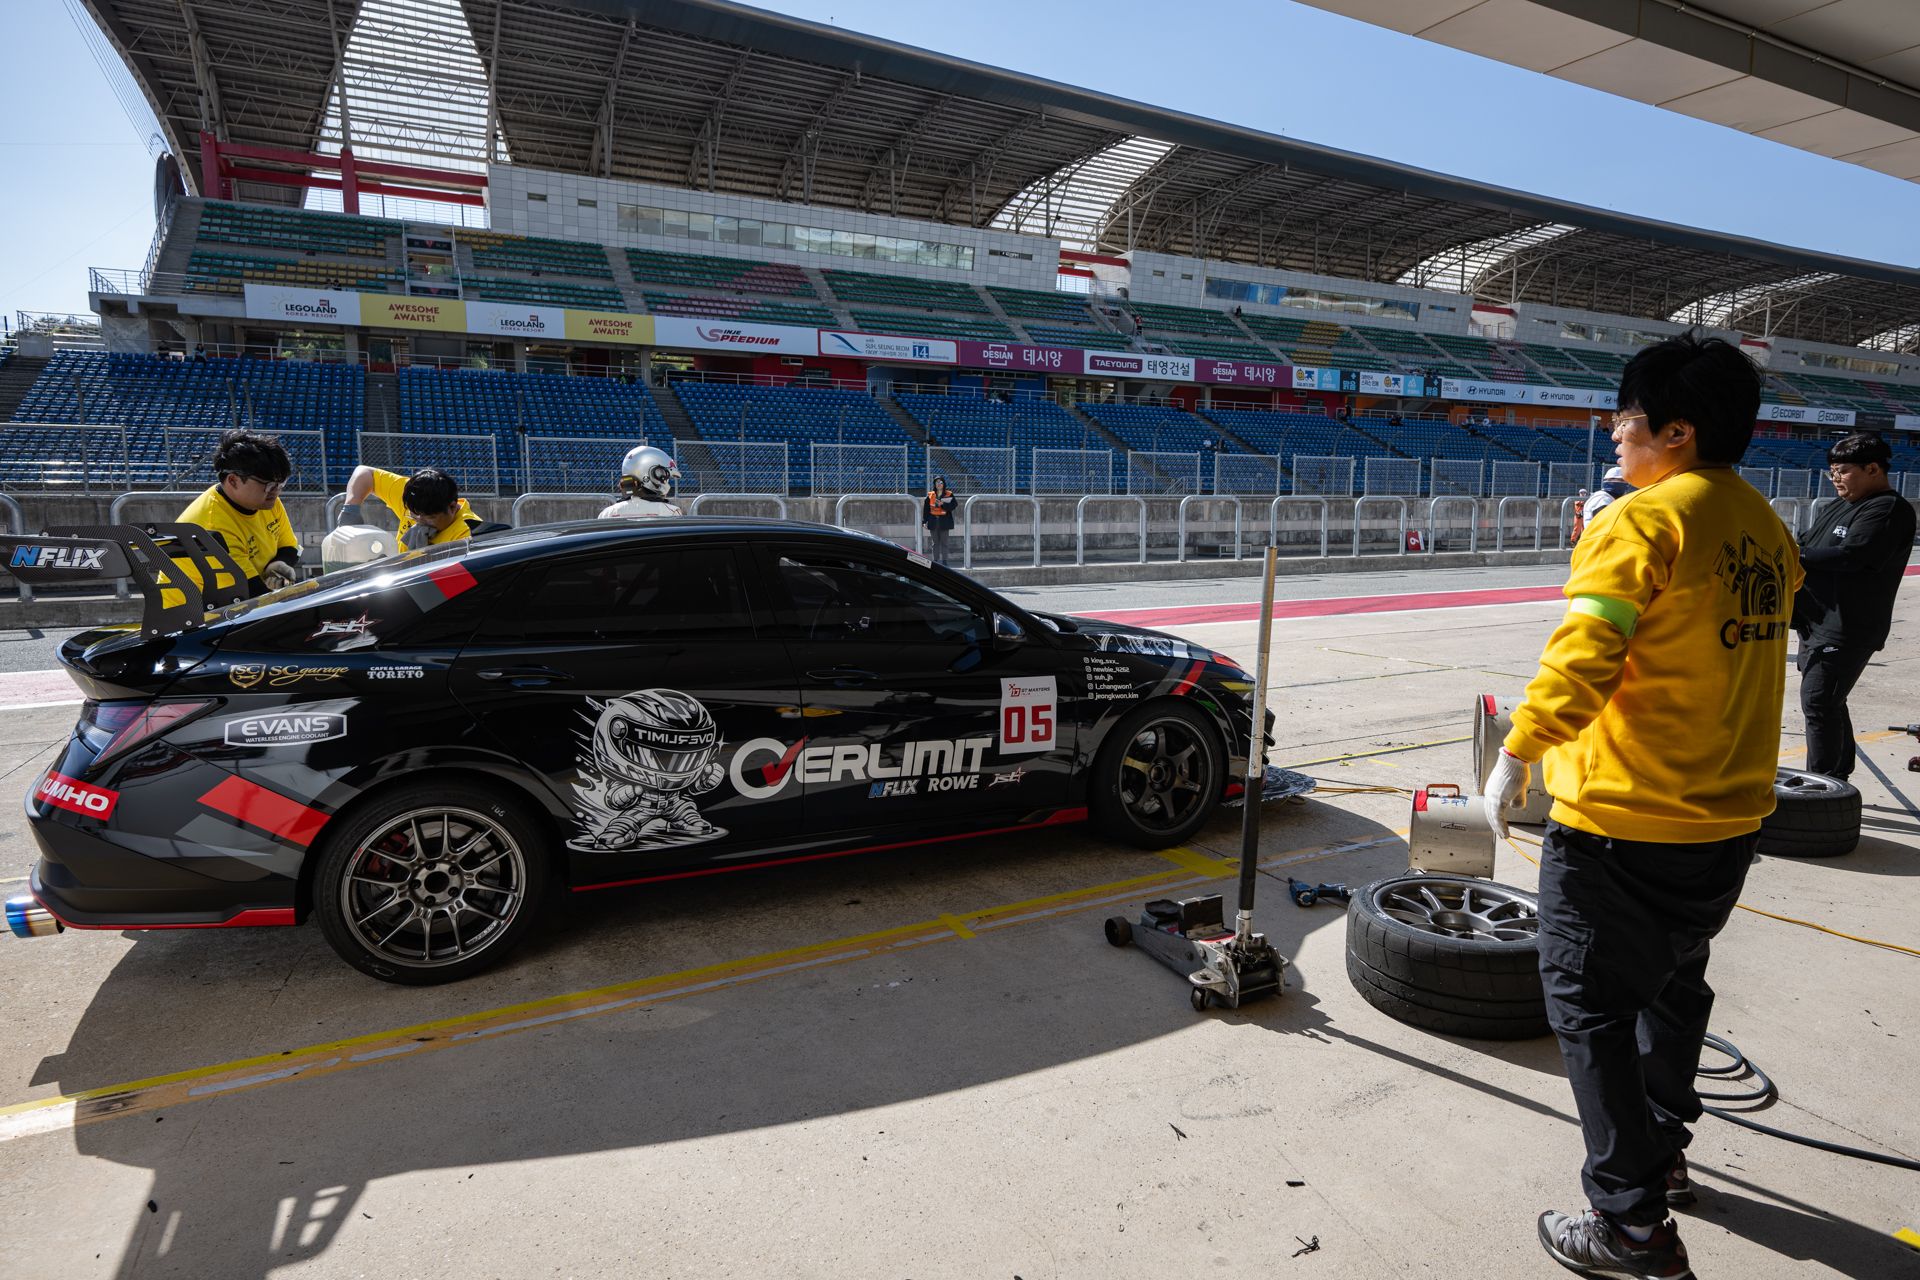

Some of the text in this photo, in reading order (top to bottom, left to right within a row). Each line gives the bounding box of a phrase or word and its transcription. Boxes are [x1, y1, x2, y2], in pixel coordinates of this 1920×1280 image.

[285, 300, 337, 314] LEGOLAND
[388, 303, 440, 314] AWESOME
[393, 313, 436, 323] AWAITS!
[500, 315, 545, 329] LEGOLAND
[588, 318, 633, 329] AWESOME
[593, 327, 630, 337] AWAITS!
[697, 327, 780, 346] SPEEDIUM
[914, 346, 929, 359] 14
[982, 350, 1013, 361] DESIAN
[1023, 349, 1063, 368] 데시앙
[1094, 358, 1139, 370] TAEYOUNG
[1147, 360, 1191, 377] 태영건설
[1212, 367, 1237, 377] DESIAN
[1244, 367, 1277, 383] 데시앙
[1478, 387, 1506, 397] HYUNDAI
[1550, 392, 1576, 401] HYUNDAI
[1779, 408, 1806, 419] ECORBIT
[1825, 412, 1850, 423] ECORBIT
[10, 545, 108, 570] NFLIX
[367, 670, 424, 680] TORETO
[241, 715, 330, 736] EVANS
[1003, 704, 1053, 745] 05
[245, 735, 279, 743] WATERLESS
[868, 778, 920, 799] NFLIX
[927, 774, 980, 793] ROWE
[39, 777, 110, 812] KUMHO
